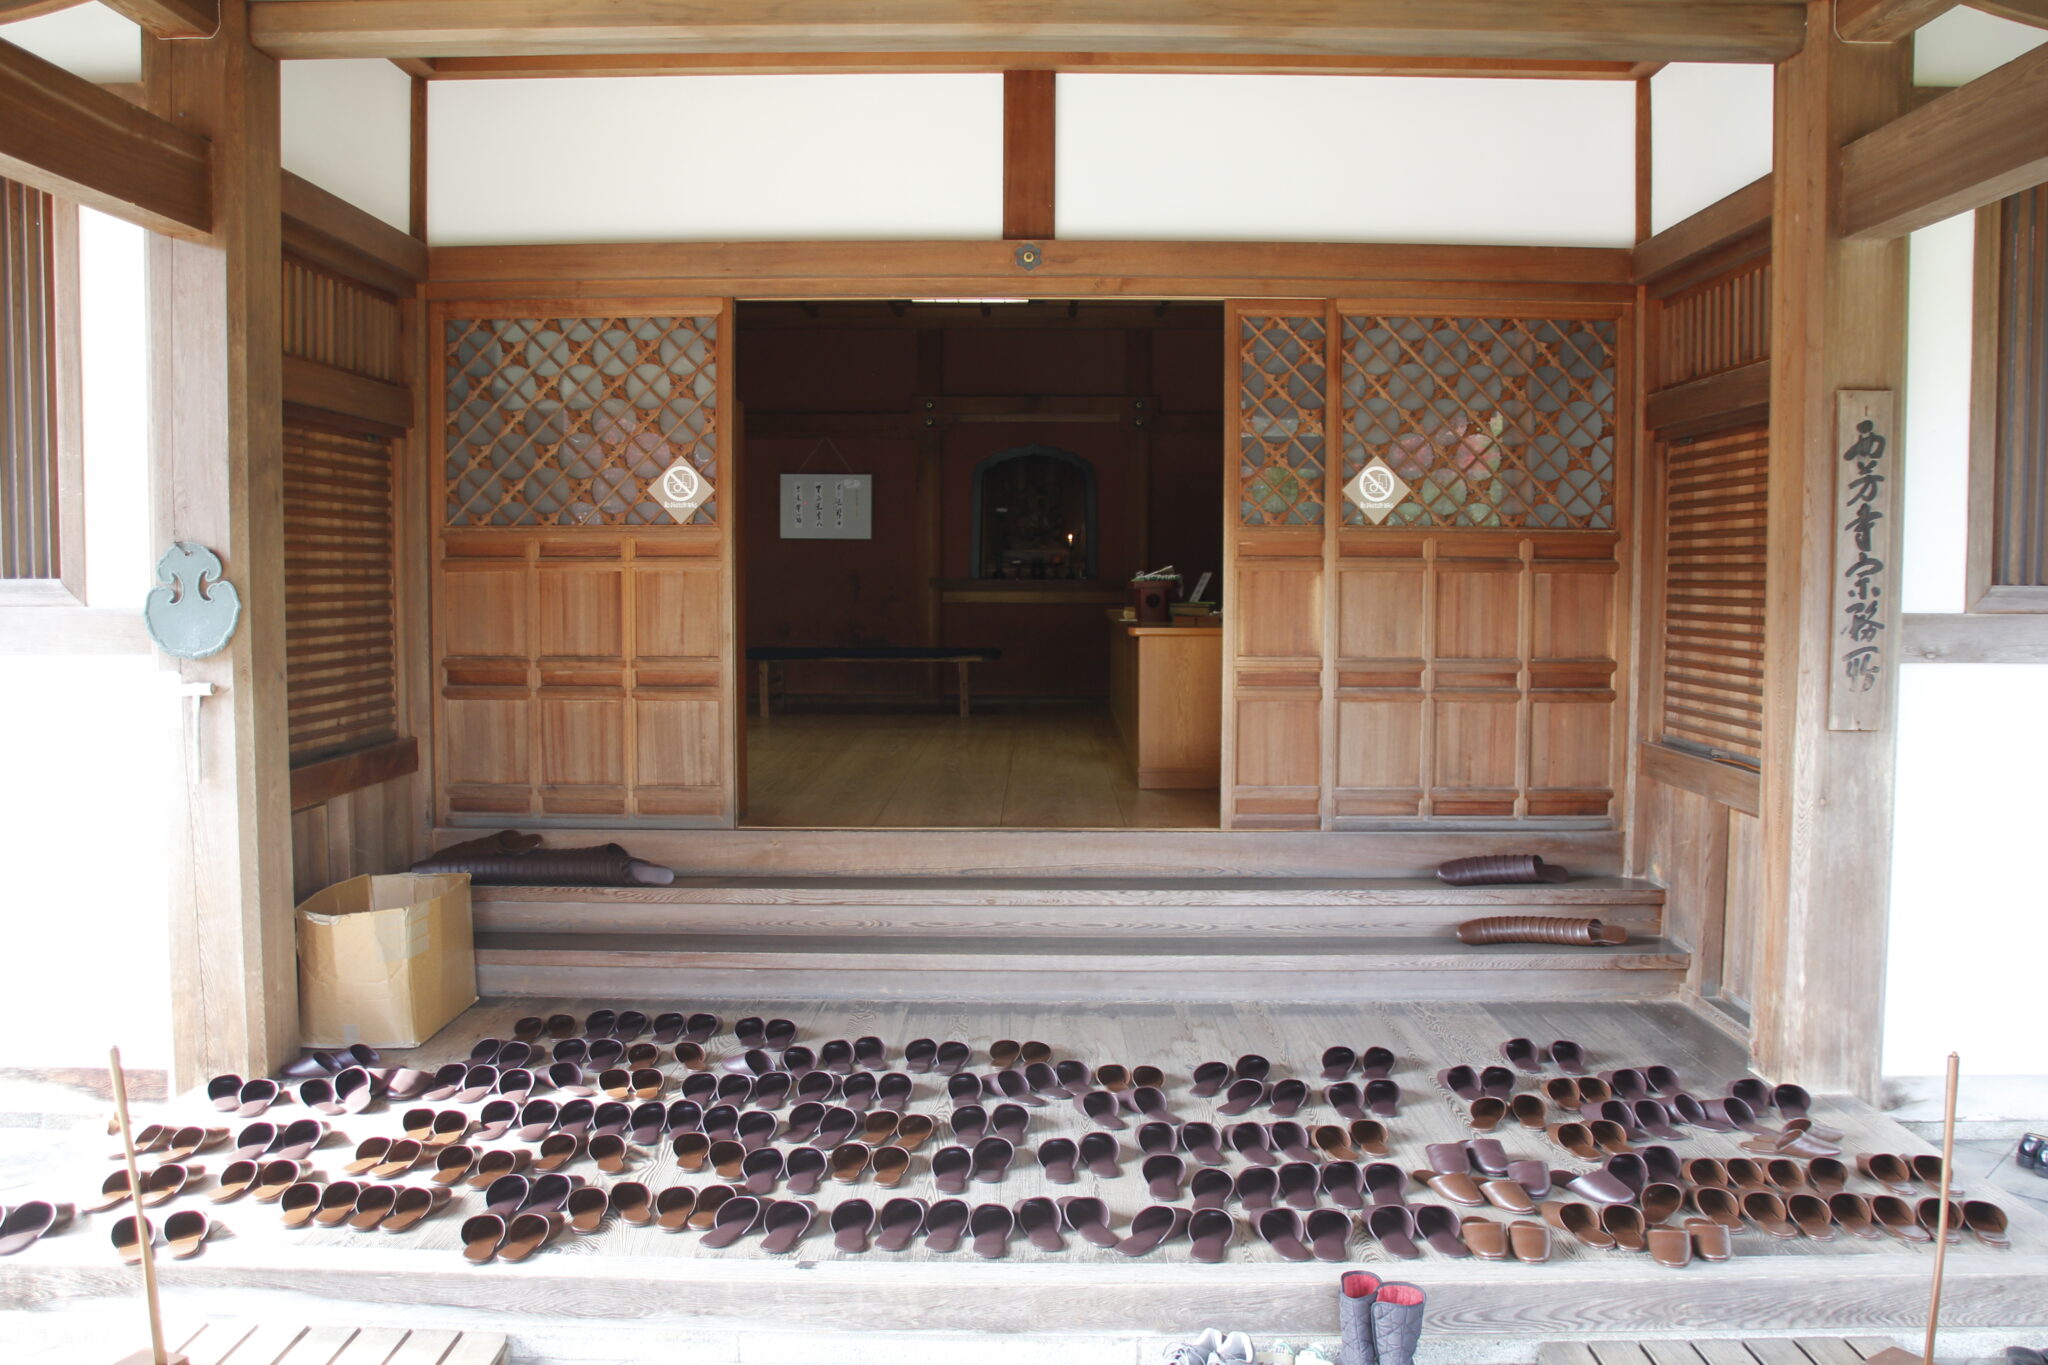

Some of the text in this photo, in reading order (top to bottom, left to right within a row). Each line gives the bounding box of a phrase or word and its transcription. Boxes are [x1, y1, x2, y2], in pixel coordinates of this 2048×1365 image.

[1841, 419, 1886, 692] 西芳寺宗務所
